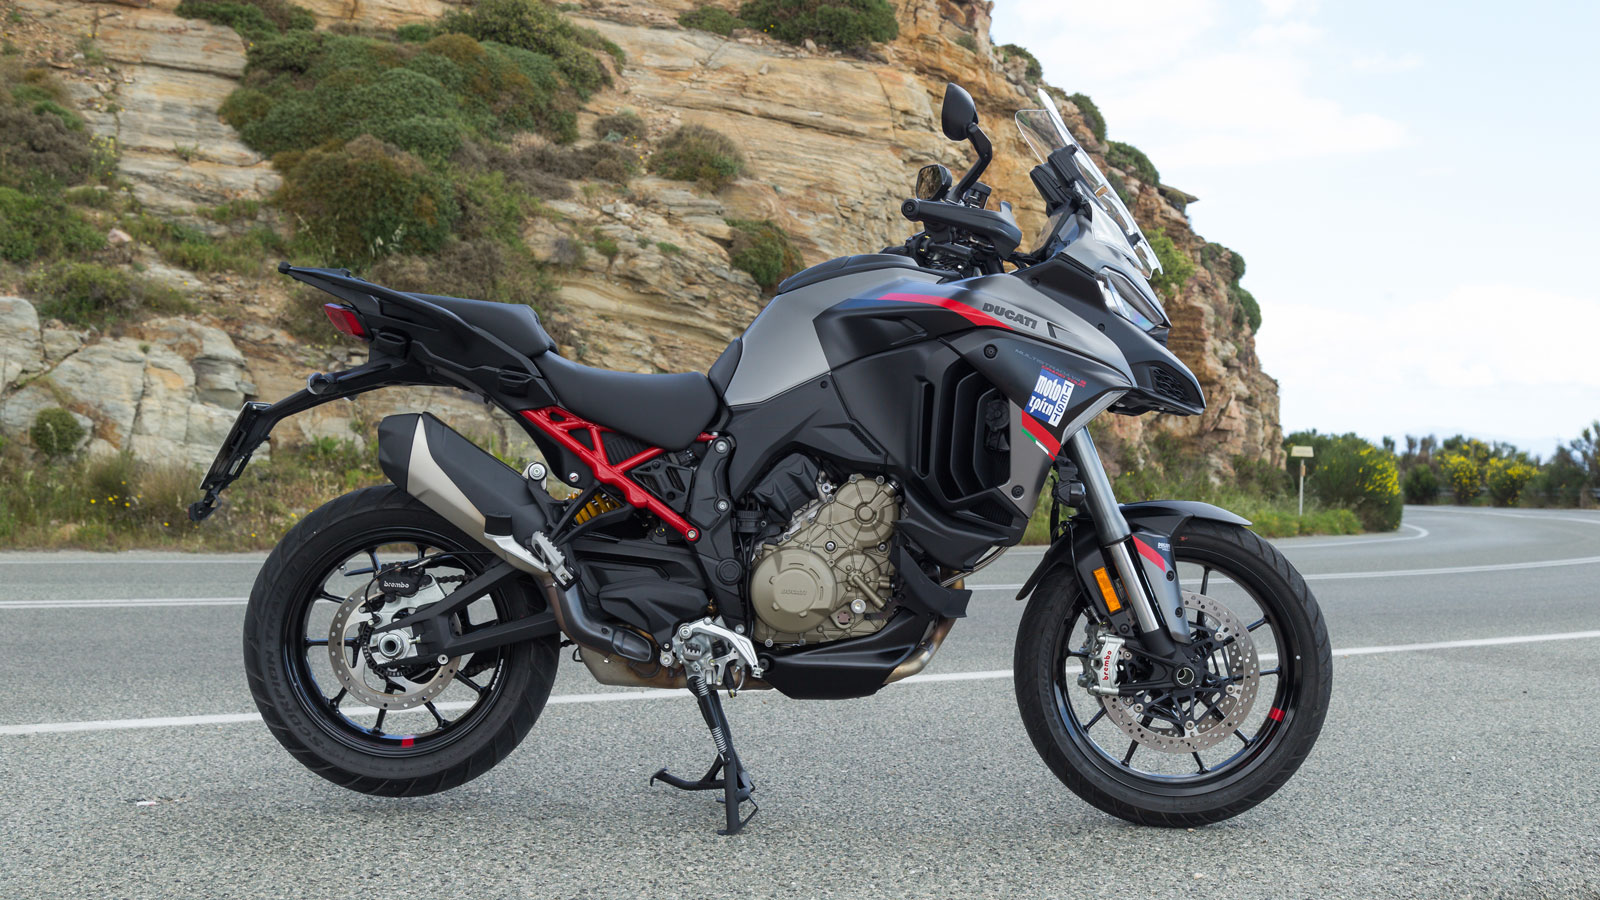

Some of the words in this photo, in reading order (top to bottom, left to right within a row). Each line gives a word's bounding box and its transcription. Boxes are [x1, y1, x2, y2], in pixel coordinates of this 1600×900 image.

[982, 302, 1037, 329] DUCATI
[1034, 374, 1061, 402] moto
[1053, 384, 1072, 422] TEST
[383, 580, 410, 589] brembo
[1102, 650, 1112, 681] brembo
